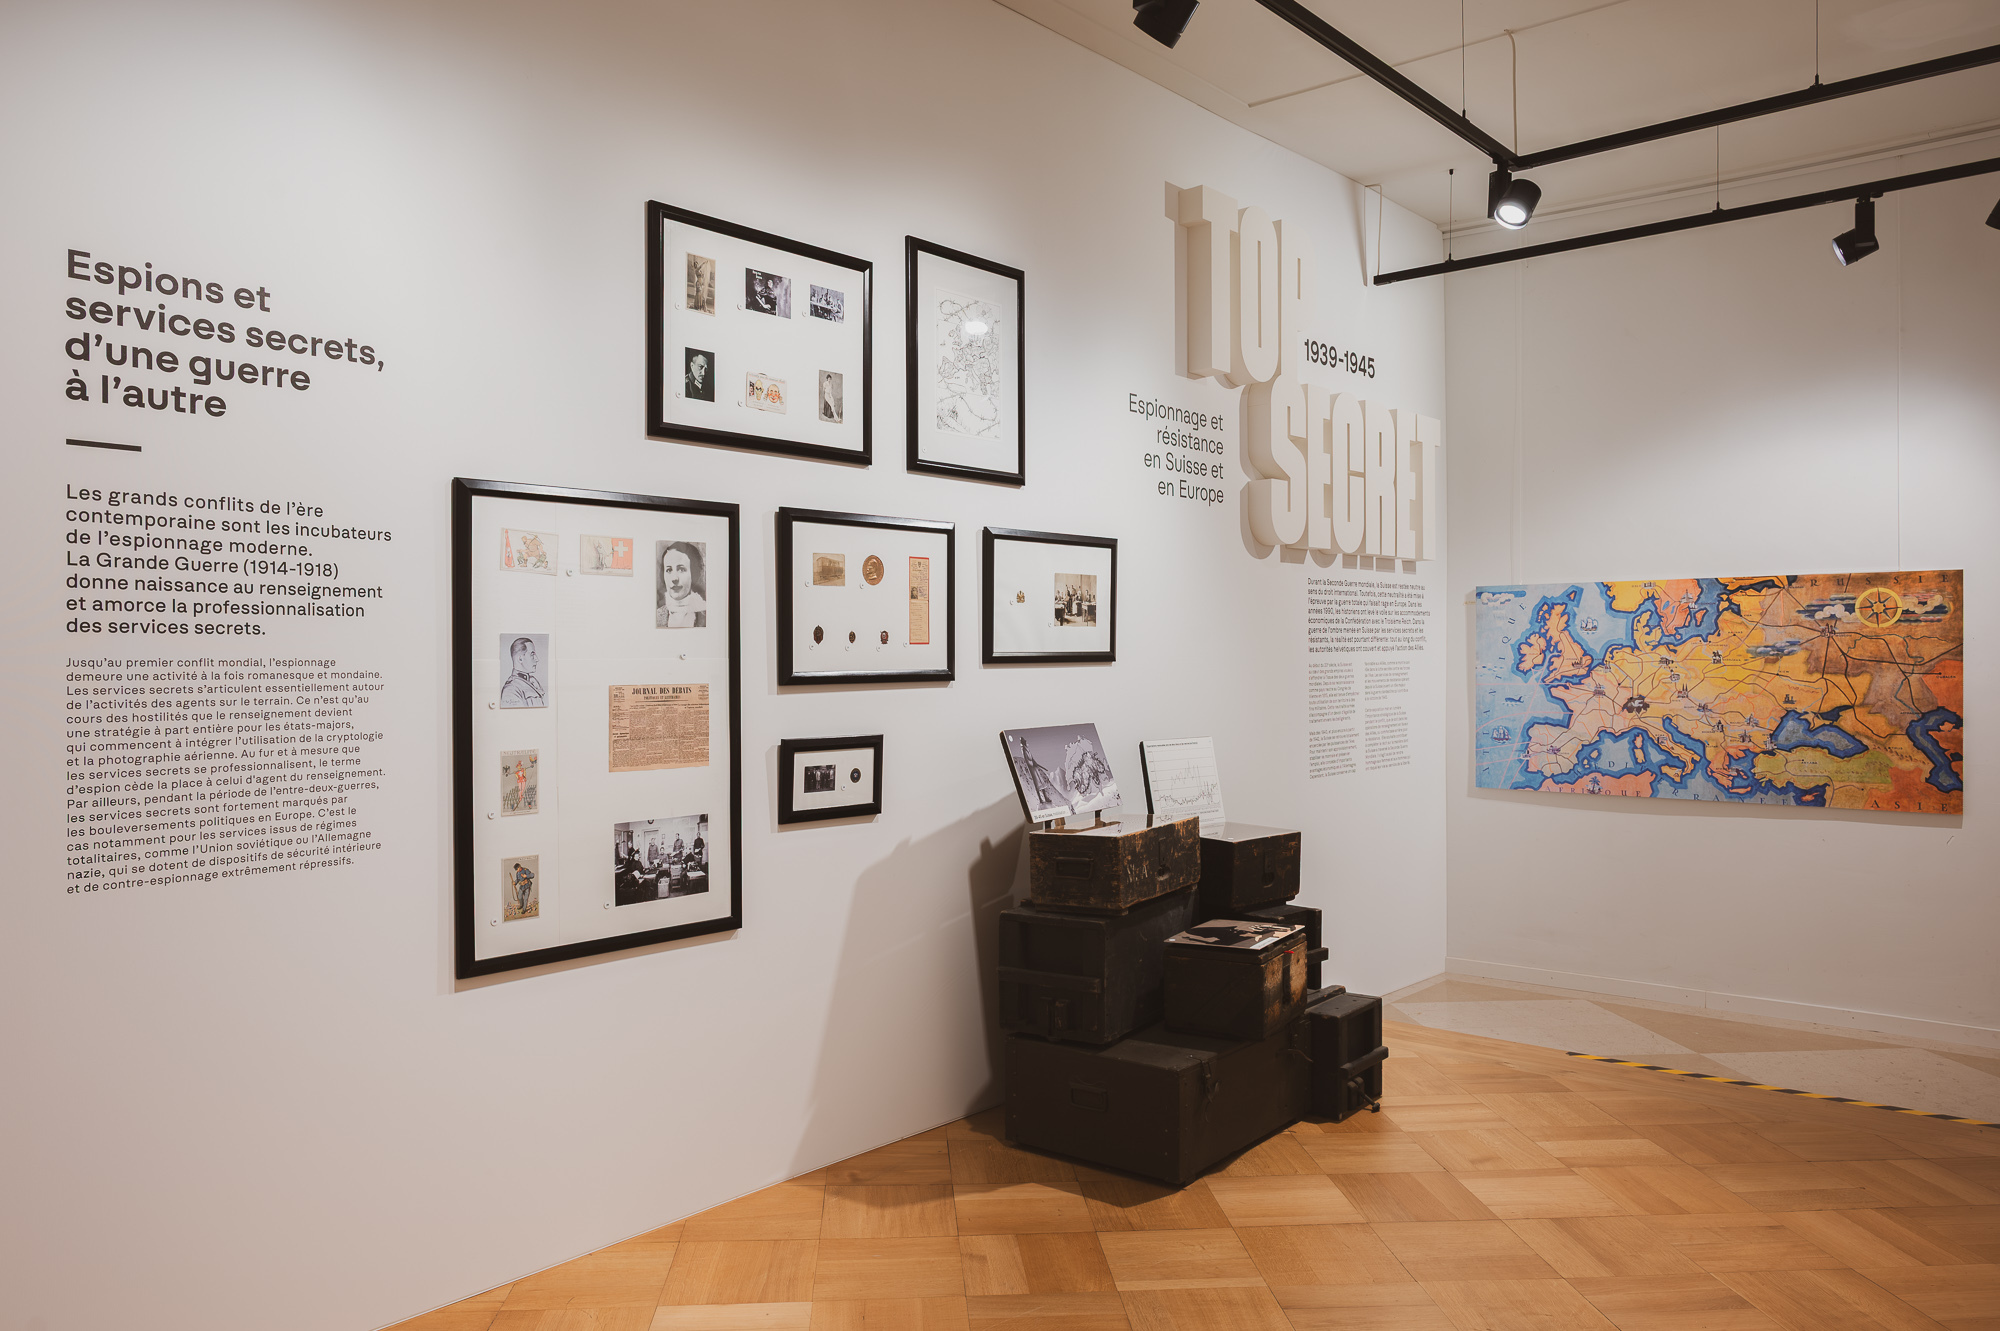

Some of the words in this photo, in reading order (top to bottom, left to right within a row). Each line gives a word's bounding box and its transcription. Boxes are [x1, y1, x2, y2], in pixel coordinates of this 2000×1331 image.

[67, 249, 224, 304] Espions
[233, 287, 271, 313] et
[1182, 184, 1317, 383] TOP
[65, 296, 236, 344] services
[245, 326, 385, 372] secrets,
[189, 354, 311, 391] guerre
[1304, 338, 1376, 379] 1939-1945
[65, 368, 89, 402] à
[1129, 393, 1208, 431] Espionnage
[1210, 413, 1224, 431] et
[1157, 425, 1224, 456] résistance
[1144, 451, 1161, 470] en
[1165, 452, 1208, 476] Suisse
[1210, 461, 1224, 480] et
[1252, 373, 1441, 562] SECRET
[66, 483, 101, 501] Les
[107, 490, 177, 507] grands
[183, 496, 254, 512] conflits
[259, 499, 280, 514] de
[1158, 479, 1175, 497] en
[1179, 480, 1224, 506] Europe
[65, 509, 215, 530] contemporaine
[221, 520, 260, 533] sont
[266, 519, 290, 535] les
[295, 521, 391, 541] incubateurs
[65, 528, 90, 544] de
[229, 540, 312, 556] moderne.
[67, 550, 90, 566] La
[96, 551, 169, 570] Grande
[174, 555, 238, 573] Guerre
[243, 558, 338, 580] (1914-1918)
[66, 572, 128, 590] donne
[134, 575, 228, 593] naissance
[233, 582, 253, 594] au
[259, 582, 382, 600] renseignement
[1810, 574, 1949, 587] RUSSIE
[66, 596, 86, 610] et
[91, 599, 166, 612] amorce
[172, 598, 187, 613] la
[193, 599, 364, 617] professionnalisation
[66, 617, 102, 633] des
[107, 618, 188, 634] services
[194, 621, 265, 635] secrets.
[65, 671, 122, 681] demeure
[126, 673, 149, 681] une
[152, 670, 197, 681] activité
[200, 670, 207, 680] à
[210, 670, 220, 680] la
[223, 670, 244, 680] fois
[247, 672, 314, 681] romanesque
[316, 670, 327, 679] et
[330, 670, 382, 679] mondaine.
[126, 657, 173, 669] premier
[176, 657, 214, 667] conflit
[218, 657, 266, 668] mondial,
[66, 685, 88, 695] Les
[92, 685, 145, 695] services
[148, 685, 193, 694] secrets
[264, 682, 349, 692] essentiellement
[352, 683, 384, 691] autour
[66, 699, 81, 709] de
[150, 698, 172, 708] des
[175, 698, 216, 710] agents
[219, 698, 237, 706] sur
[240, 696, 250, 706] le
[253, 695, 293, 705] terrain.
[295, 695, 310, 705] Ce
[632, 687, 658, 695] JOURNAL
[660, 686, 670, 694] DES
[66, 715, 102, 724] cours
[105, 713, 128, 723] des
[131, 711, 188, 722] hostilités
[191, 712, 212, 722] que
[216, 710, 225, 720] le
[229, 708, 311, 721] renseignement
[314, 707, 352, 717] devient
[66, 756, 79, 766] et
[83, 755, 94, 765] la
[98, 752, 180, 767] photographie
[183, 750, 237, 761] aérienne.
[240, 749, 255, 758] Au
[258, 748, 274, 757] fur
[277, 747, 288, 756] et
[290, 746, 297, 756] à
[300, 746, 339, 755] mesure
[341, 745, 360, 755] que
[124, 780, 153, 791] cède
[157, 780, 167, 789] la
[171, 778, 202, 791] place
[205, 776, 212, 786] à
[215, 775, 242, 786] celui
[289, 772, 303, 781] du
[306, 768, 385, 784] renseignement.
[66, 813, 85, 823] les
[88, 809, 142, 821] services
[145, 806, 190, 817] secrets
[193, 803, 219, 814] sont
[222, 799, 279, 812] fortement
[282, 795, 328, 809] marqués
[331, 796, 347, 806] par
[67, 799, 88, 809] Par
[91, 796, 140, 807] ailleurs,
[144, 792, 193, 806] pendant
[196, 791, 206, 800] la
[209, 788, 251, 803] période
[253, 787, 267, 796] de
[1871, 800, 1948, 812] ASIE
[66, 883, 80, 894] et
[83, 881, 99, 892] de
[102, 871, 218, 890] contre-espionnage
[221, 862, 296, 878] extrêmement
[299, 856, 354, 870] répressifs.
